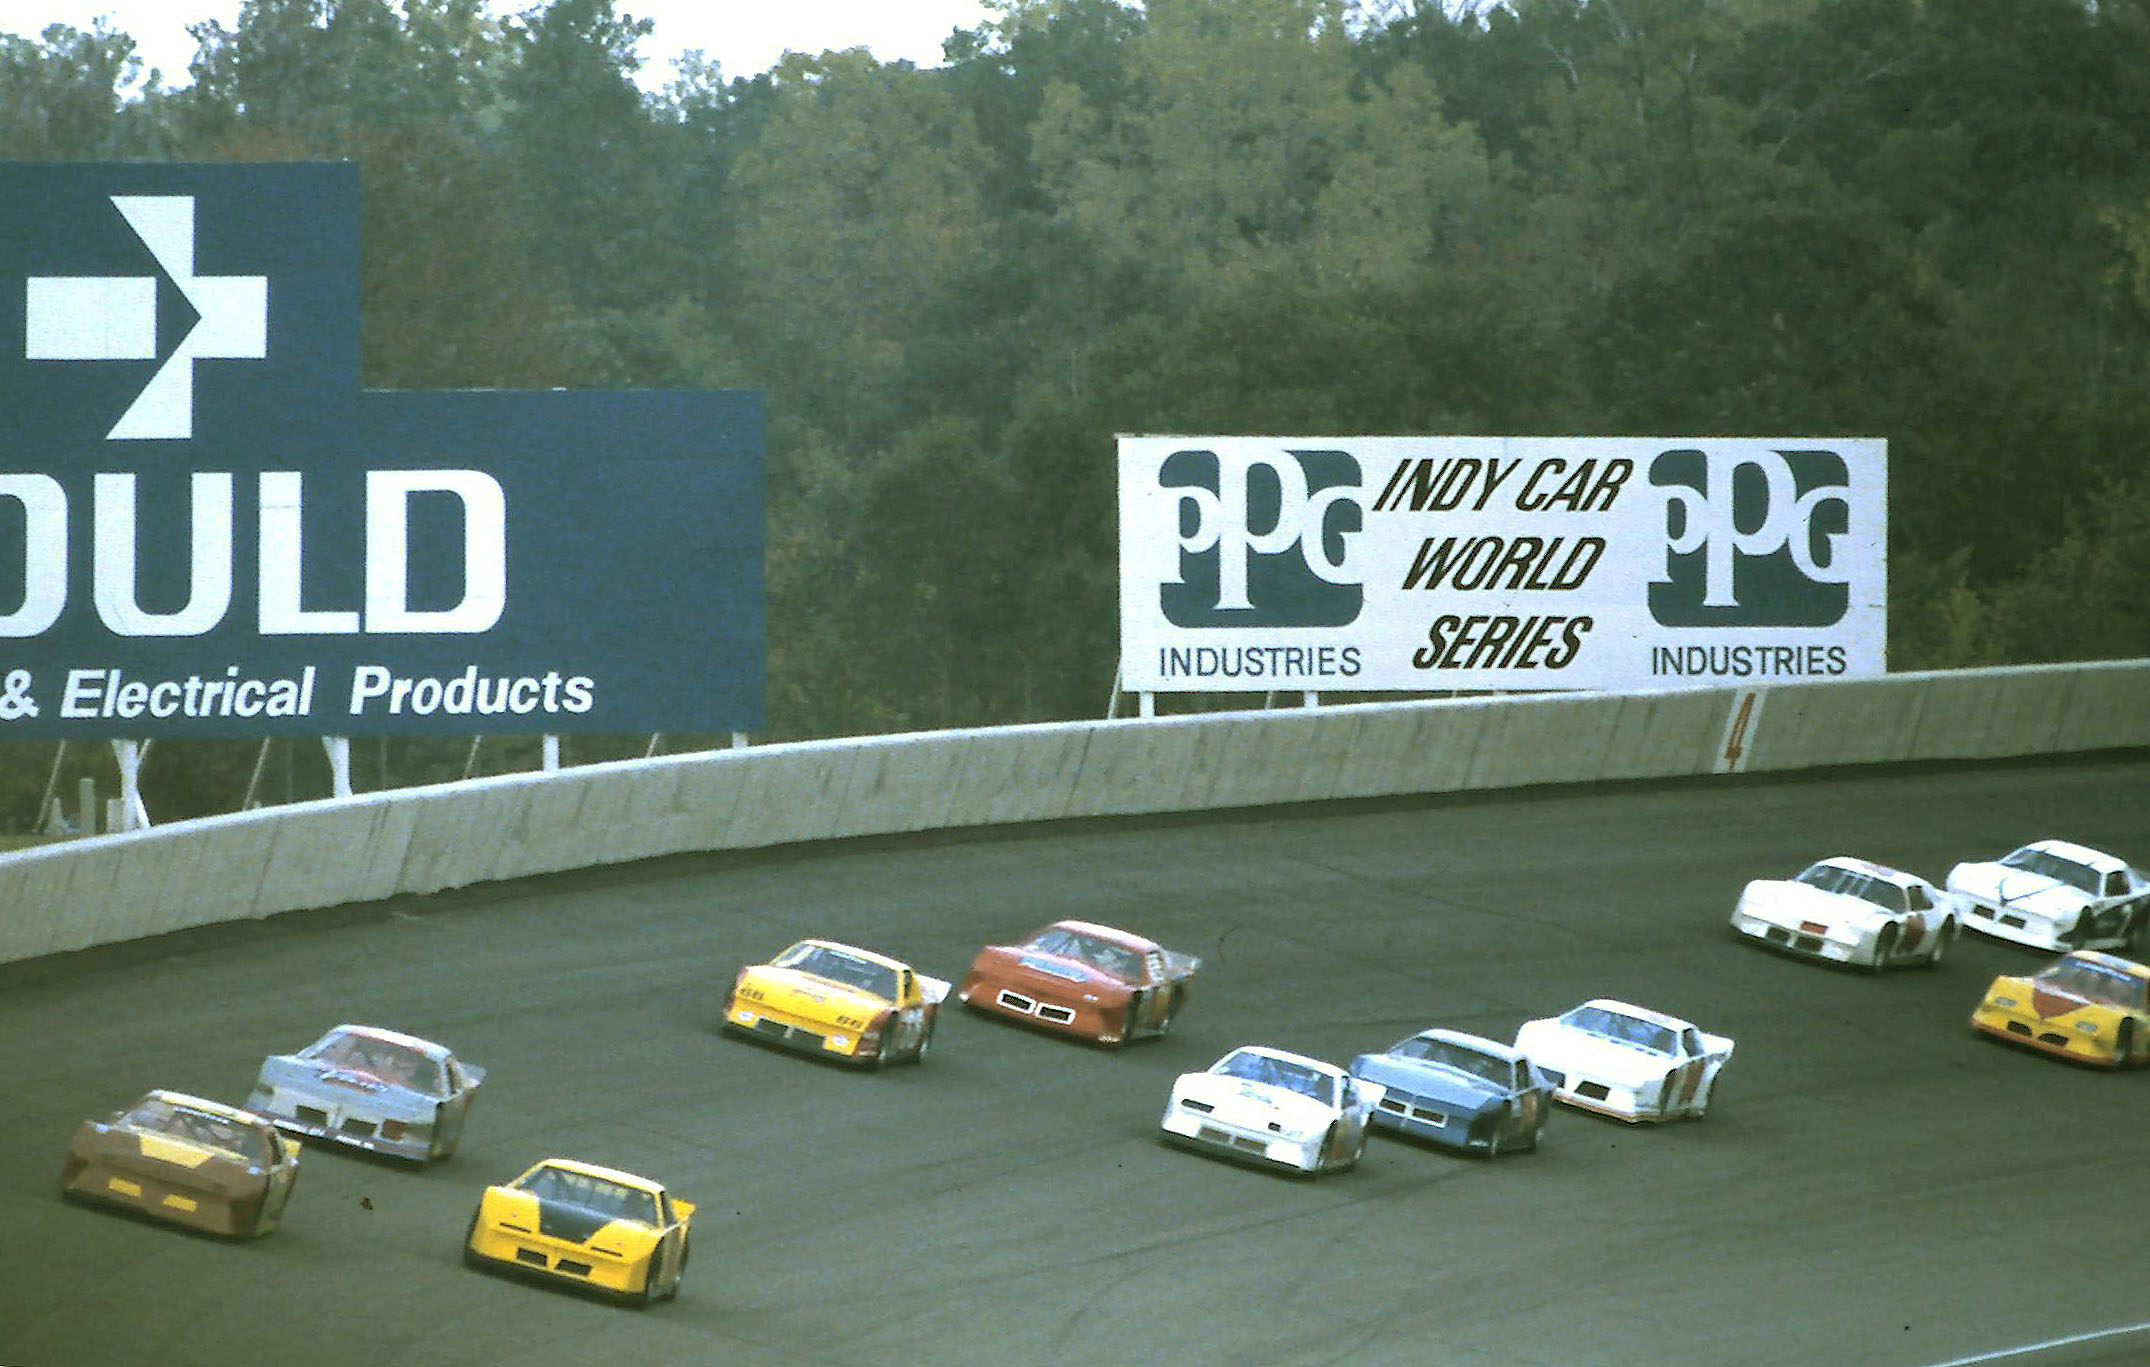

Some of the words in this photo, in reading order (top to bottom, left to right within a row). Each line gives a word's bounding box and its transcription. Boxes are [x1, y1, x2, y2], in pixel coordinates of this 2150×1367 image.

[1373, 457, 1519, 512] INDY
[1516, 457, 1633, 512] CAR
[1160, 448, 1363, 611] PPG
[1648, 447, 1850, 608] PPG
[1401, 535, 1606, 591] WORLD
[1159, 646, 1361, 678] INDUSTRIES
[1412, 614, 1593, 671] SERIES
[1652, 645, 1848, 676] INDUSTRIES
[0, 668, 40, 721] &
[59, 665, 317, 719] Electrical
[350, 665, 595, 716] Products
[1723, 692, 1756, 770] 4
